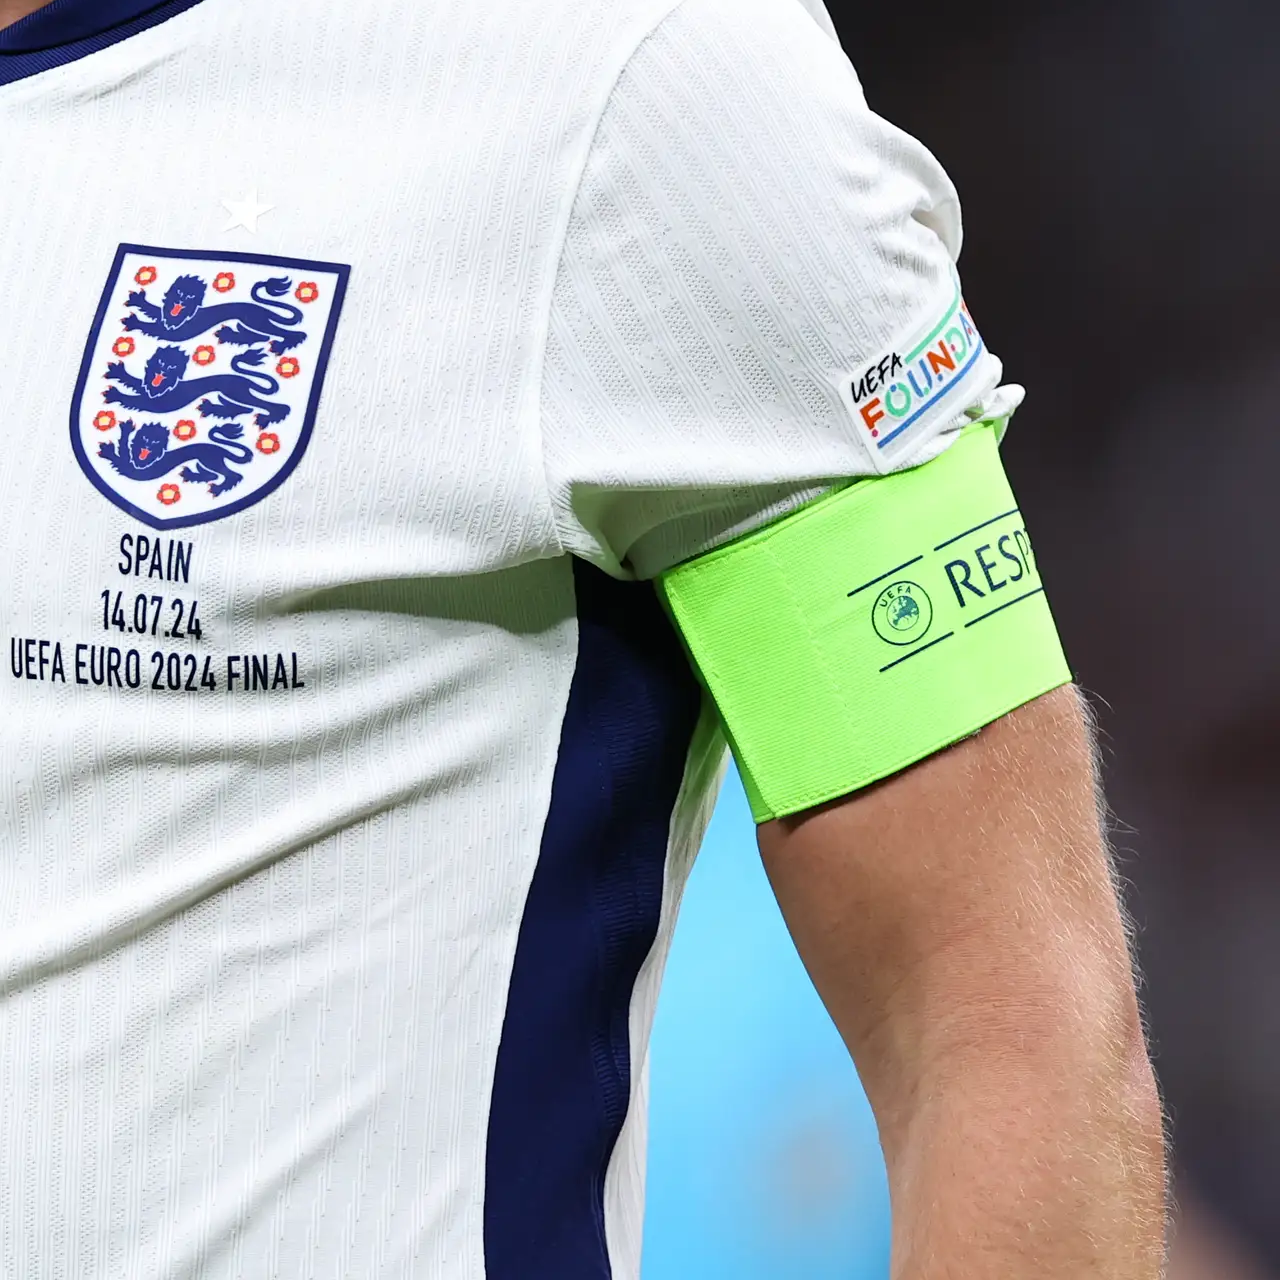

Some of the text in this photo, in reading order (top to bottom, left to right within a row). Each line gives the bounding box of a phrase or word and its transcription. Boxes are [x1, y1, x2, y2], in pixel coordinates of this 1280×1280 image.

[851, 352, 903, 403] UEFA
[859, 301, 977, 437] FOUNDA
[118, 533, 193, 583] SPAIN
[944, 528, 1030, 608] RESP
[101, 589, 202, 640] 14.07.24
[879, 585, 911, 608] UEFA
[10, 637, 305, 691] UEFA EURO 2024 FINAL
